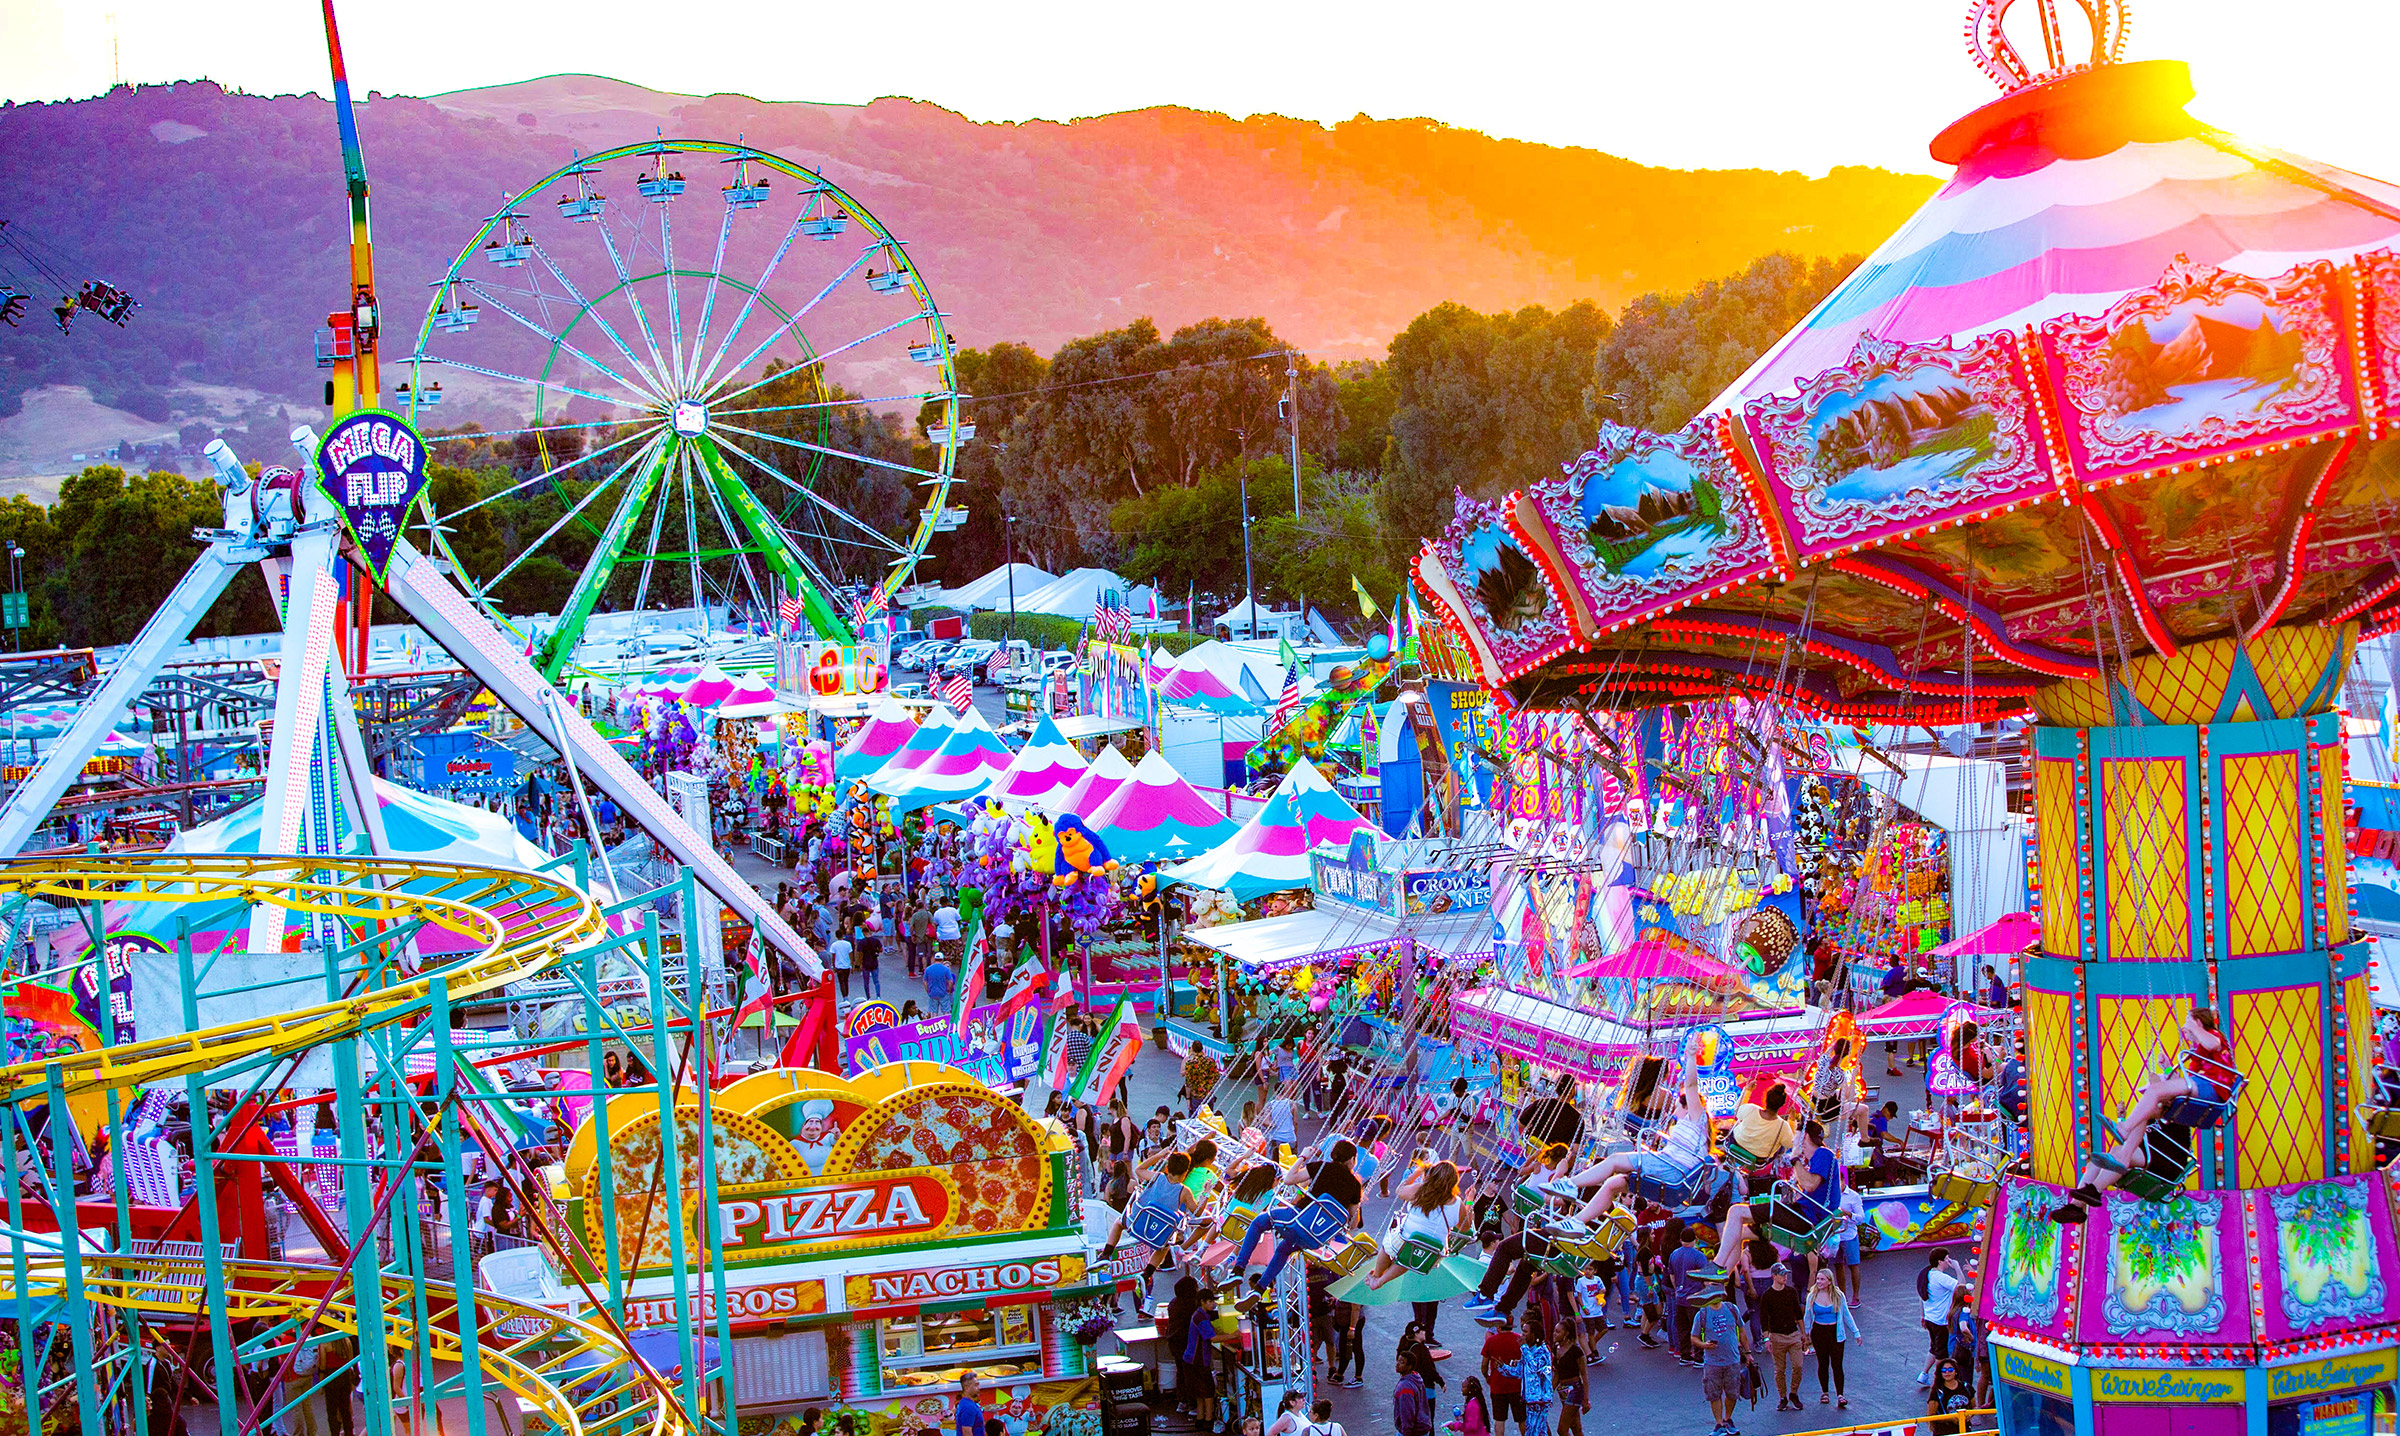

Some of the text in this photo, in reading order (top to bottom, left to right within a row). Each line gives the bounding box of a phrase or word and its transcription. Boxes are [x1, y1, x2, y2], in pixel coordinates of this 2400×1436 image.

[327, 422, 415, 477] MEGA
[346, 471, 409, 507] FLIP
[819, 645, 878, 697] BIG
[1450, 689, 1491, 709] SHOOT
[1412, 873, 1483, 896] CROW'S
[1457, 890, 1491, 909] NES
[855, 1008, 894, 1036] MEGA
[718, 1184, 931, 1245] PIZZA
[872, 1260, 1062, 1301] NACHOS
[2005, 1353, 2063, 1390] Oktoberfest
